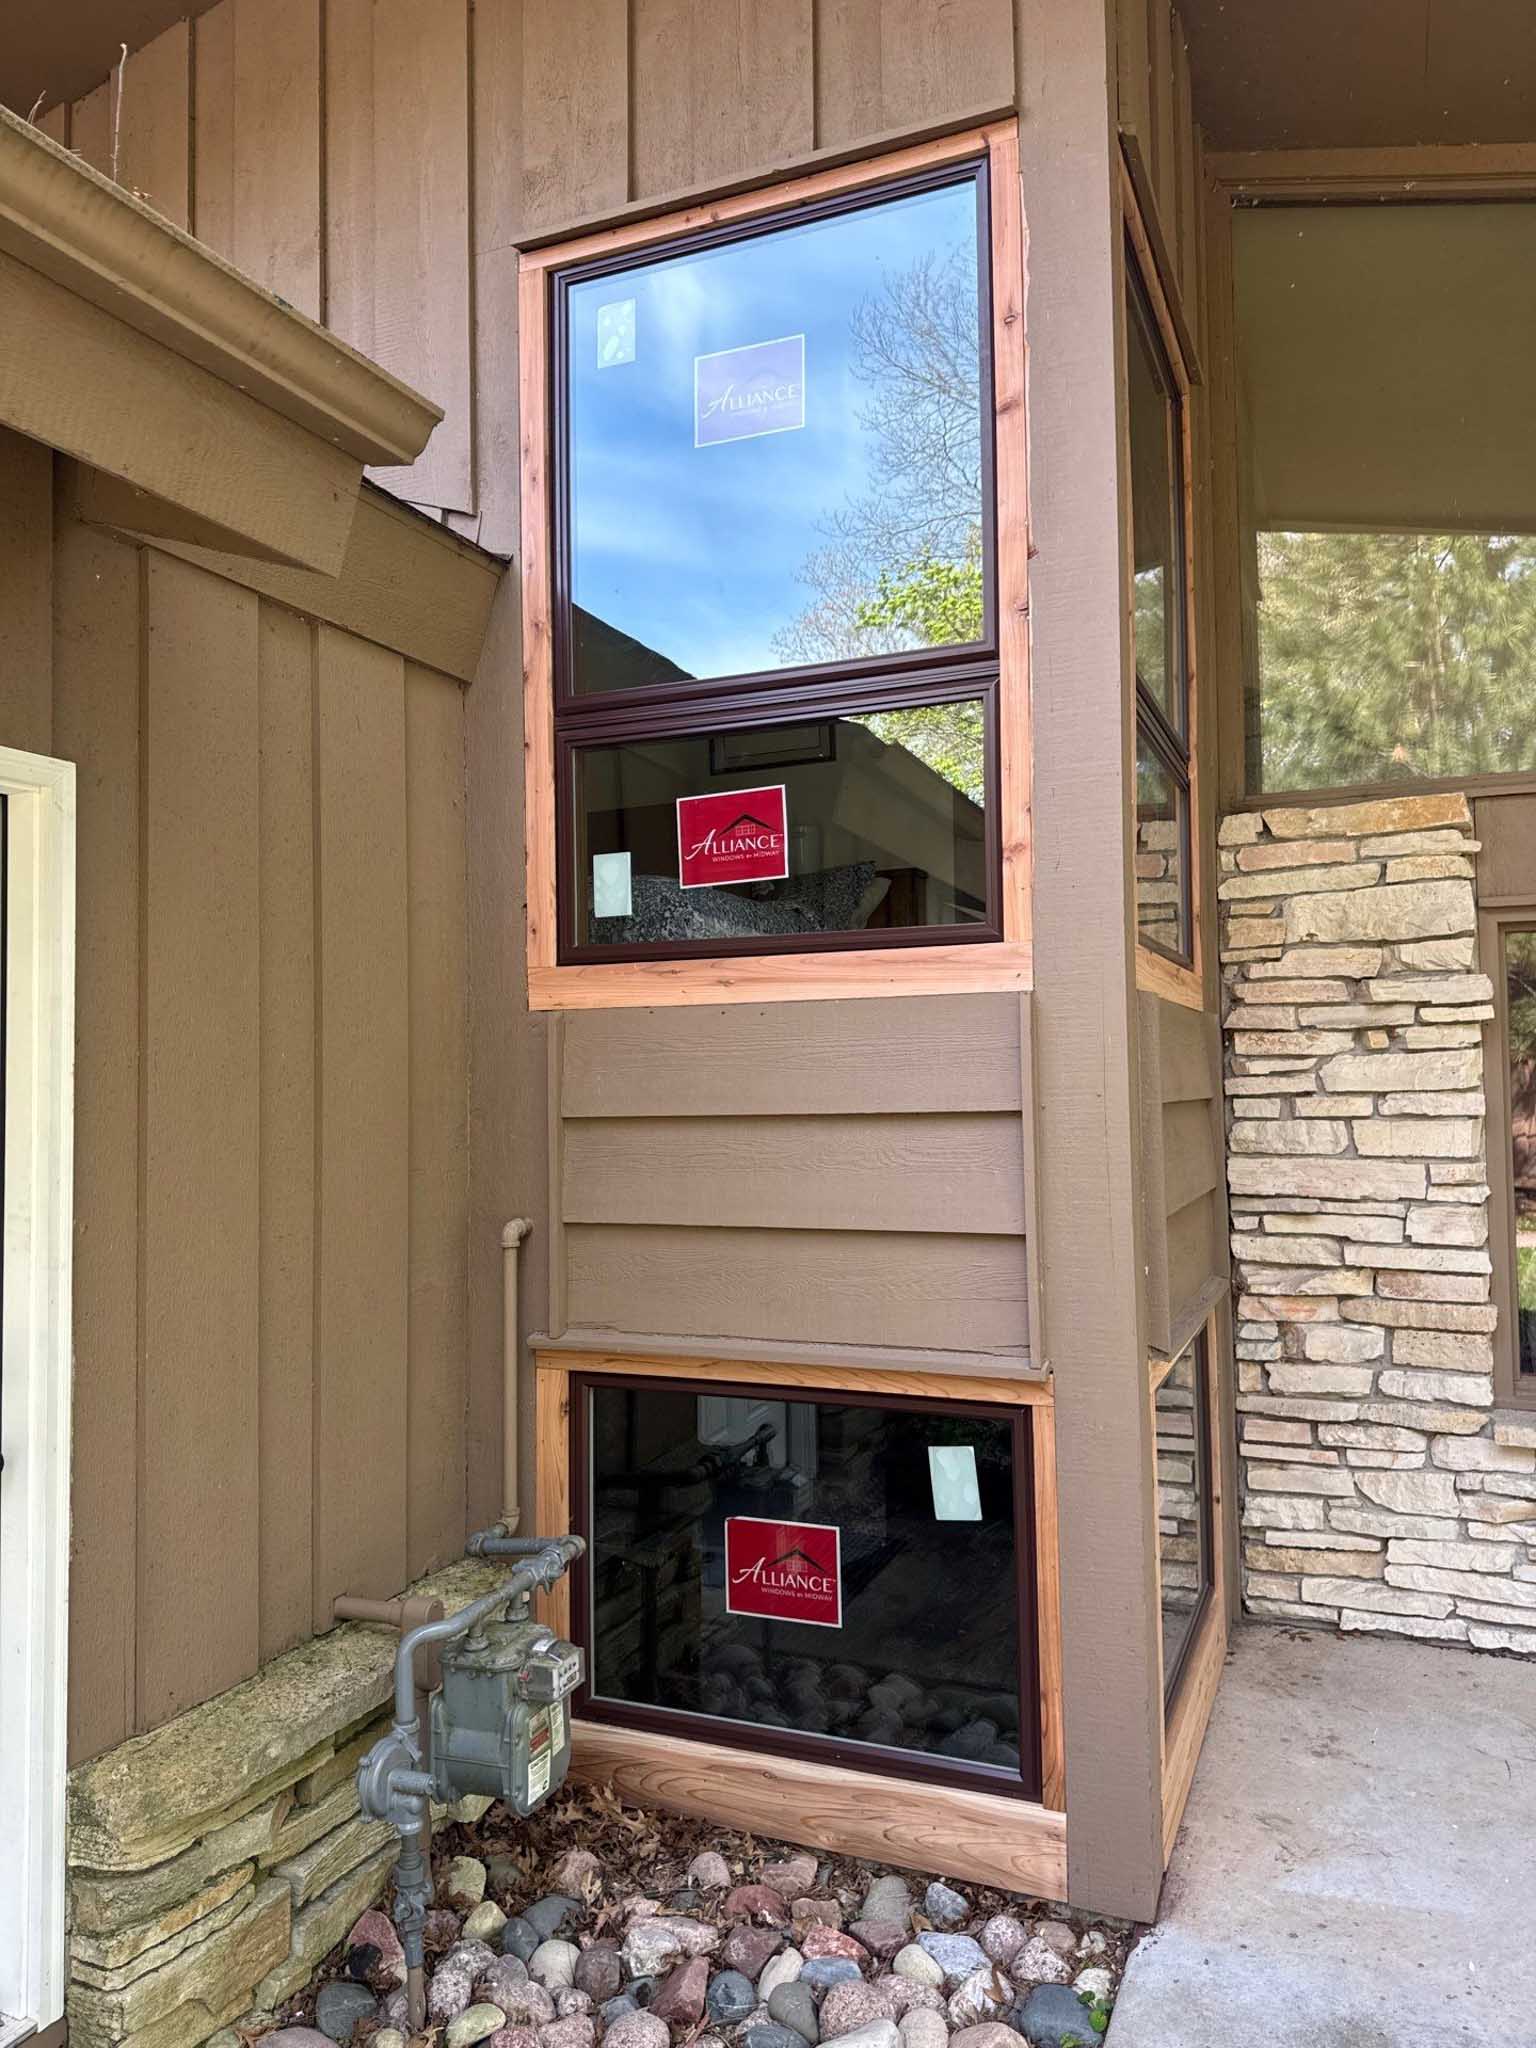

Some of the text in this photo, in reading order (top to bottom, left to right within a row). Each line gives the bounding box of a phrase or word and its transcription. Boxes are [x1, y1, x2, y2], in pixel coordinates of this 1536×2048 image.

[702, 383, 801, 419] ALLIANCE
[684, 828, 781, 861] ALLIANCE
[712, 854, 744, 862] WINDOWS
[732, 1557, 833, 1593] ALLIANCE
[761, 1586, 796, 1597] WINDOWS
